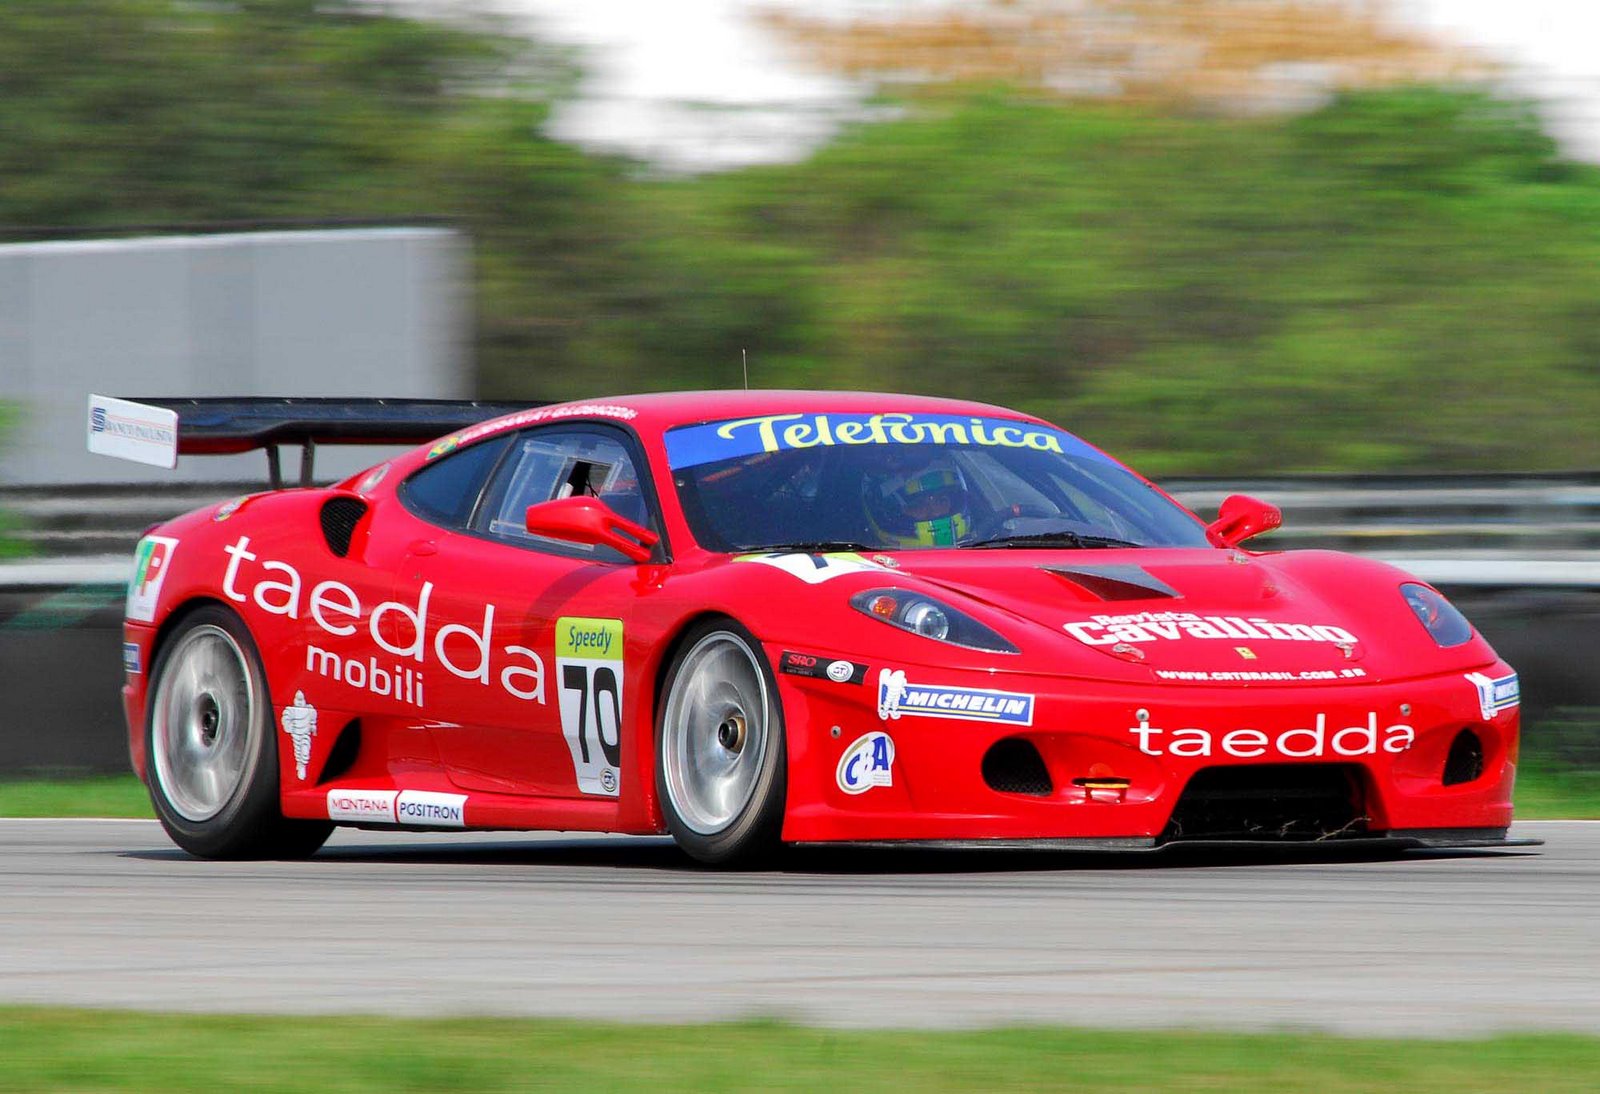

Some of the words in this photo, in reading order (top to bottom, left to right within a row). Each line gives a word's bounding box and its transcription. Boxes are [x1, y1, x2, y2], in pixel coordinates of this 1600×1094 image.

[222, 536, 545, 705] taedda
[1063, 616, 1359, 645] Cavallino
[568, 626, 612, 654] Speedy
[788, 654, 817, 667] SRO
[306, 645, 423, 707] mobili
[563, 665, 621, 767] 70
[906, 691, 1027, 715] MICHELIN
[1130, 711, 1415, 757] taedda
[332, 798, 389, 811] MONTANA
